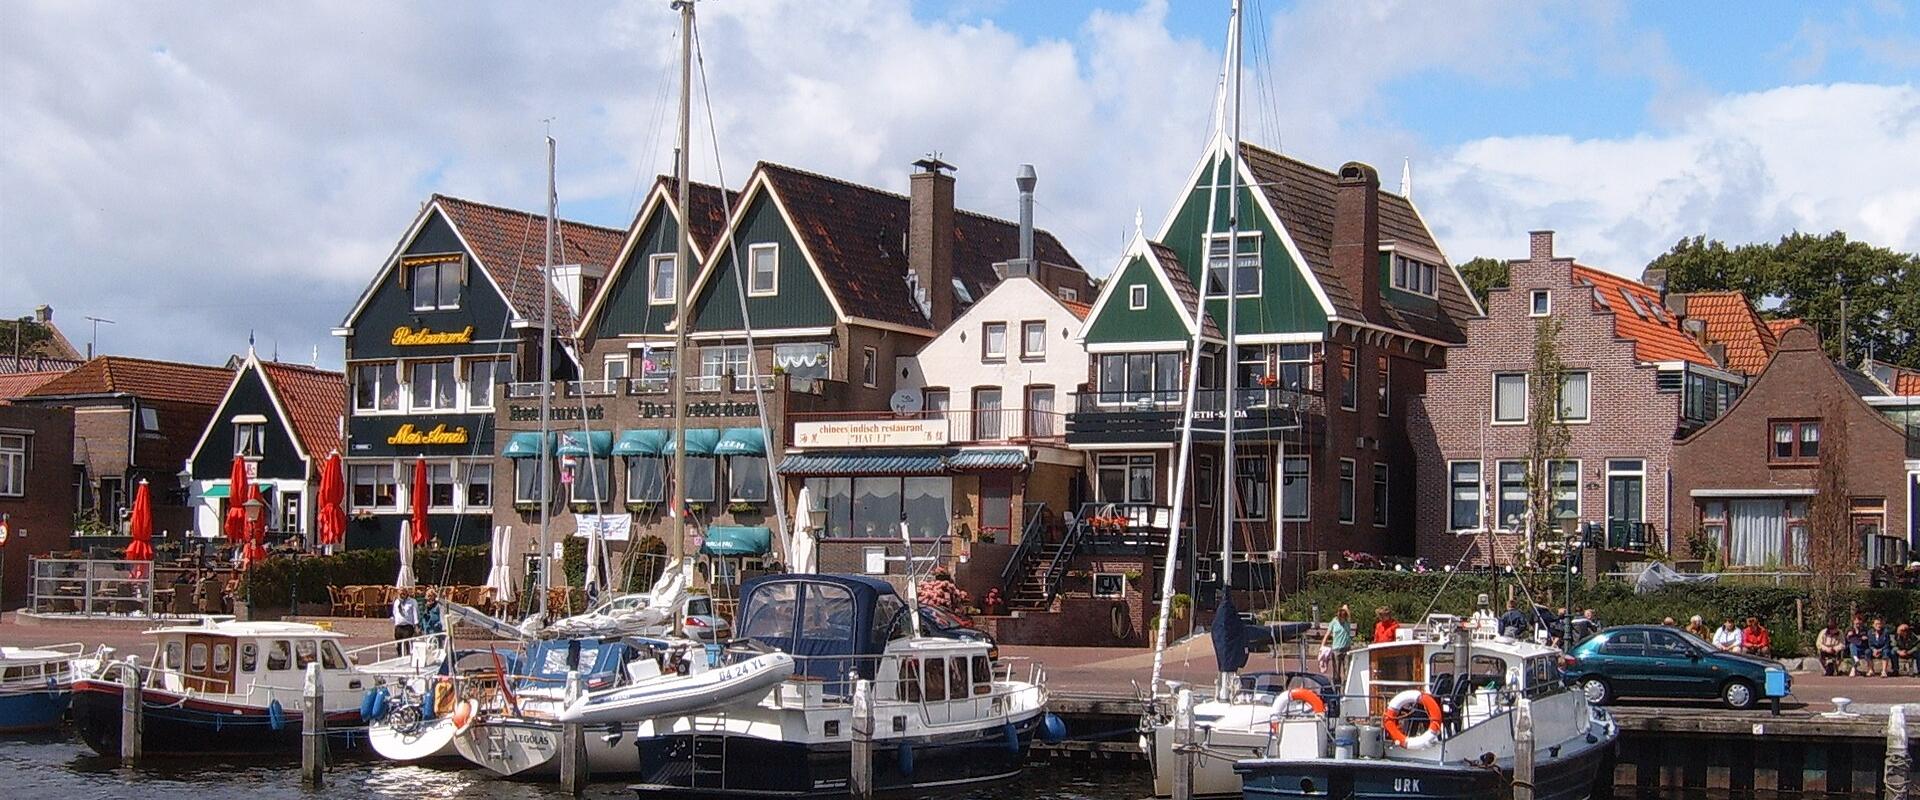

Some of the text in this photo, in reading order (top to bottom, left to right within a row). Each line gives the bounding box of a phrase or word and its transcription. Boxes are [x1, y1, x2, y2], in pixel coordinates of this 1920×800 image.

[391, 325, 474, 346] Restaurant
[509, 402, 604, 421] Resturant
[819, 423, 923, 434] chinees indisch restaurant
[735, 663, 749, 677] 24
[751, 659, 766, 670] YL
[514, 734, 549, 745] LEGOLAS
[1394, 778, 1420, 792] URK
